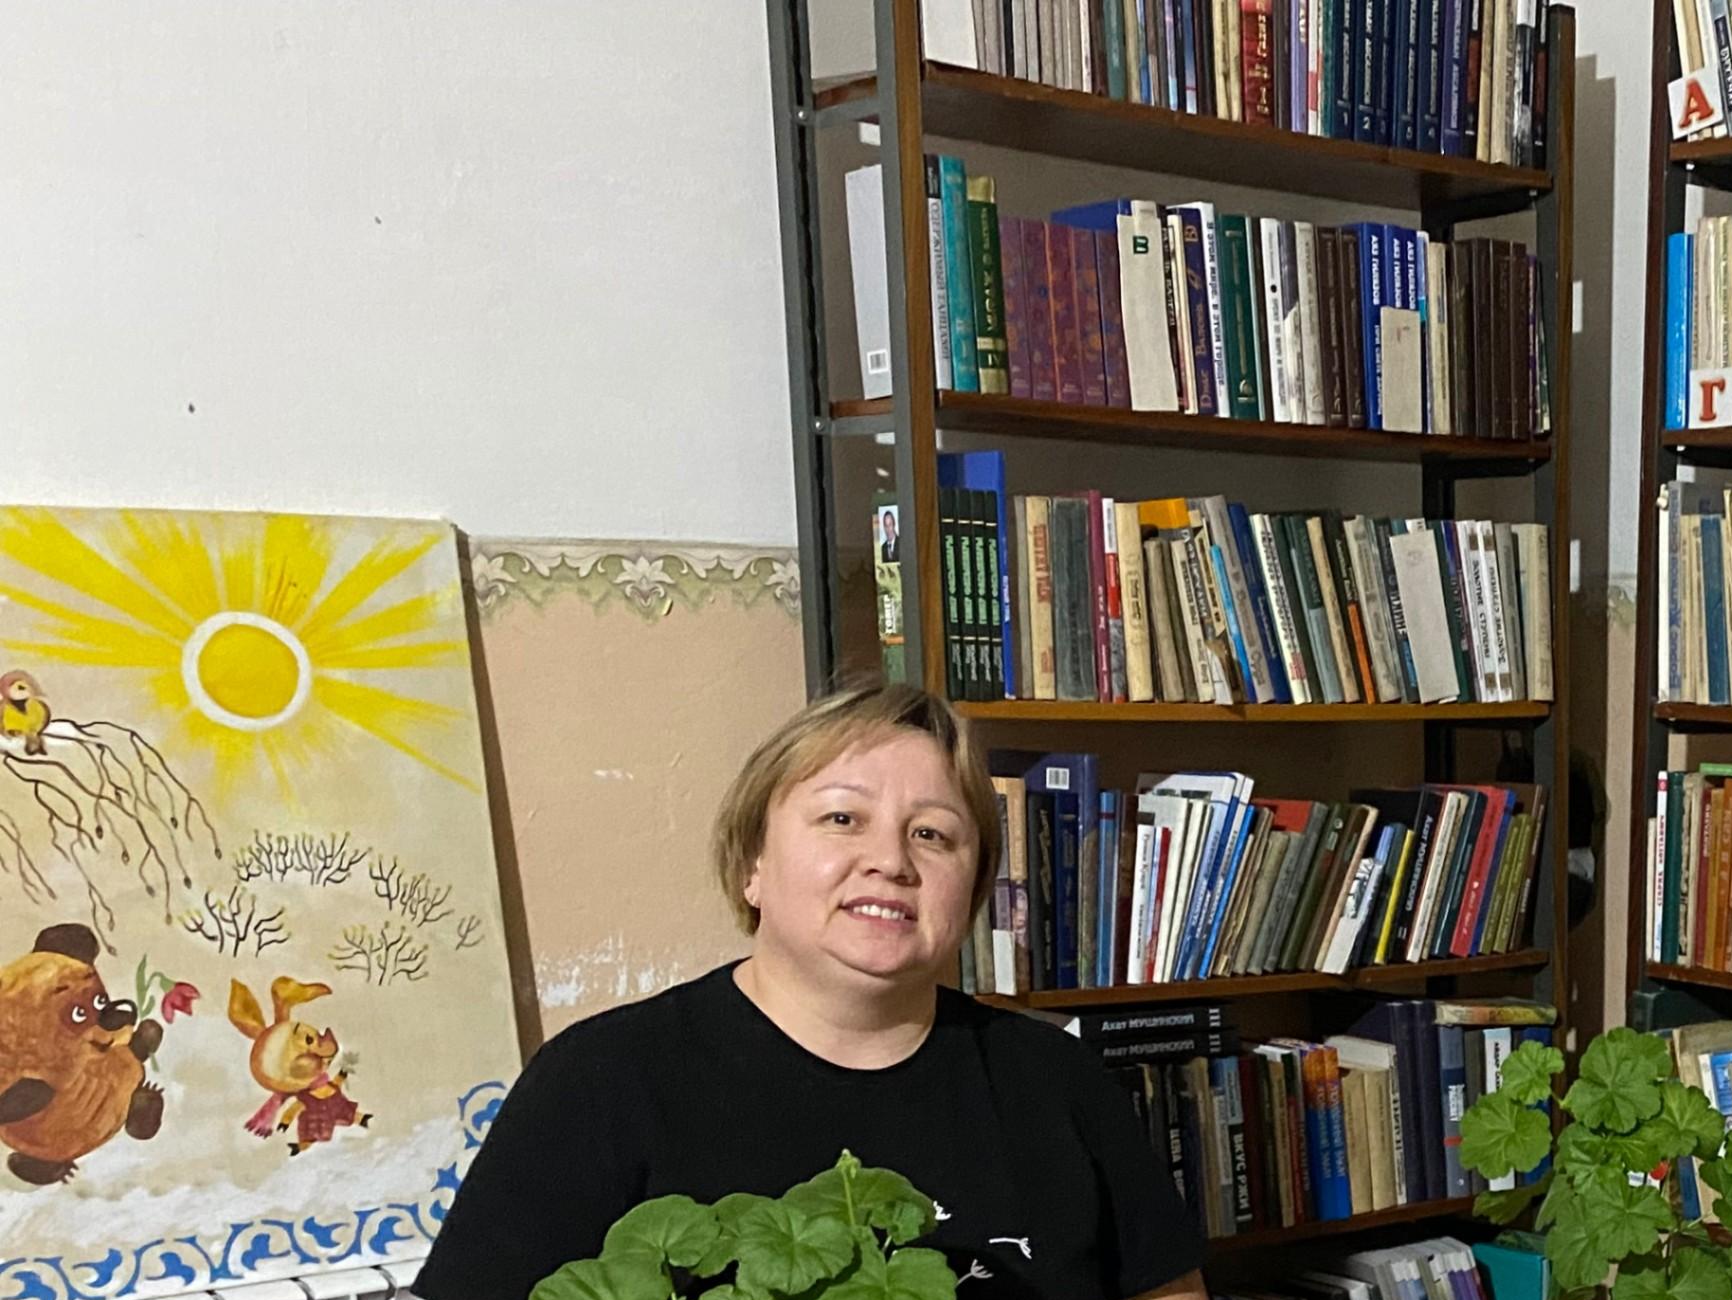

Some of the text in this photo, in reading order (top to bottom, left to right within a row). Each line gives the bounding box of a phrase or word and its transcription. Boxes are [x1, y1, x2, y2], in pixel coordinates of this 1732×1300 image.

[1679, 78, 1714, 129] А
[1698, 377, 1726, 422] Г
[1233, 1134, 1250, 1209] ВКУС РЖИ
